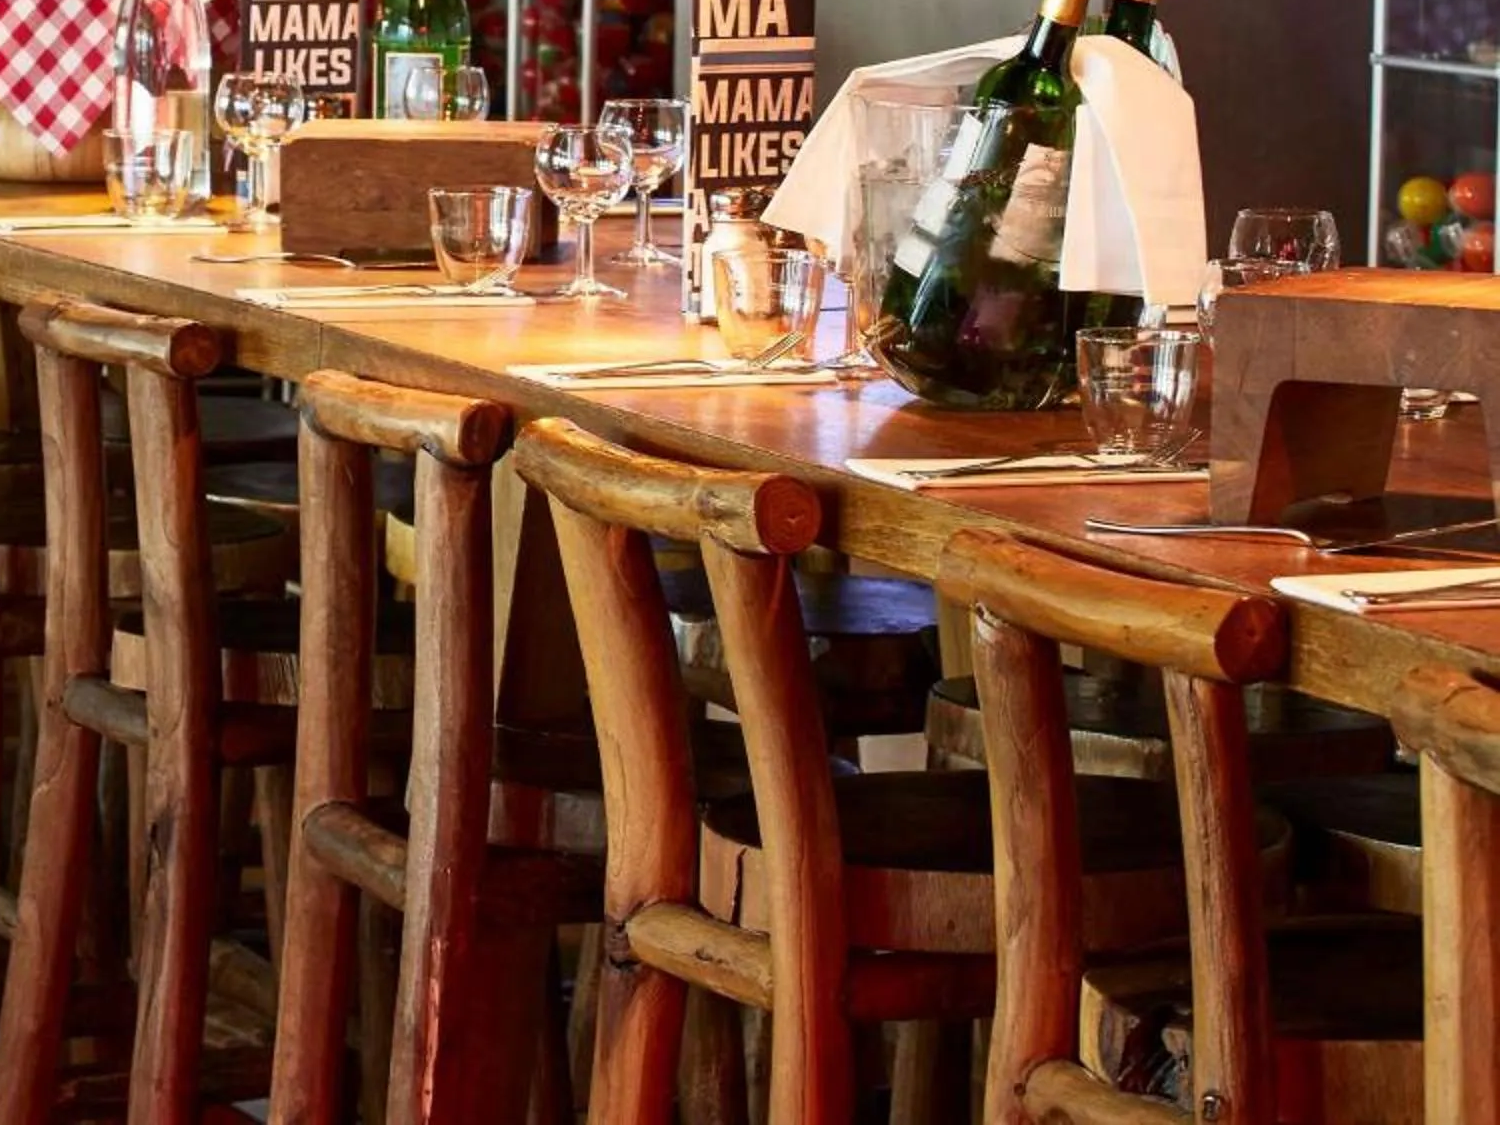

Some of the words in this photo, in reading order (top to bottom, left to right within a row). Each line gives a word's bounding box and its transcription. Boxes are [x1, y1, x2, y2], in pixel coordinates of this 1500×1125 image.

[250, 3, 358, 42] MAMA
[255, 48, 352, 86] LIKES
[696, 77, 813, 123] MAMA
[701, 131, 805, 178] LIKES
